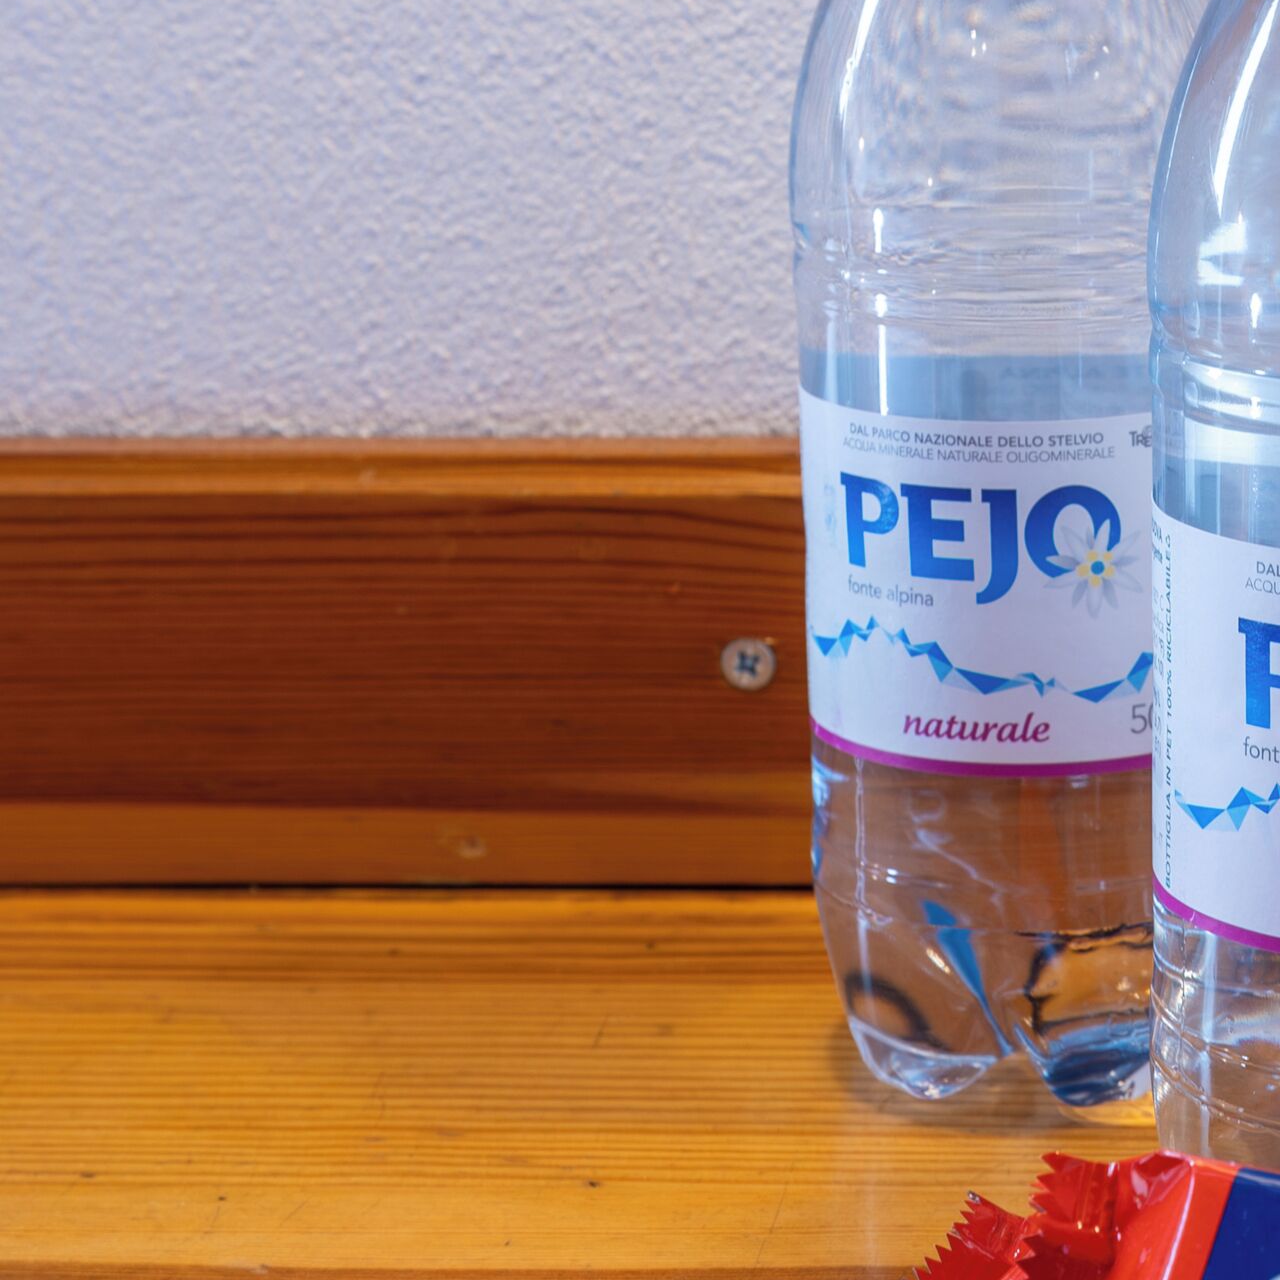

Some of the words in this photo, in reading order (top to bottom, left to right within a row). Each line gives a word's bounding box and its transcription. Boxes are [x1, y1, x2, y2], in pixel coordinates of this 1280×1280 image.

[843, 437, 878, 453] ACQUA
[878, 444, 934, 460] MINERALE
[937, 449, 1003, 463] NATURALE
[1006, 446, 1115, 464] OLIGOMINERALE
[850, 422, 869, 437] DAL
[872, 426, 911, 442] PARCO
[914, 432, 993, 448] NAZIONALE
[998, 436, 1044, 448] DELLO
[1048, 432, 1104, 447] STELVIO
[840, 471, 1122, 605] PEJO
[848, 574, 882, 600] fonte
[887, 579, 934, 607] alpina
[903, 712, 1050, 743] naturale
